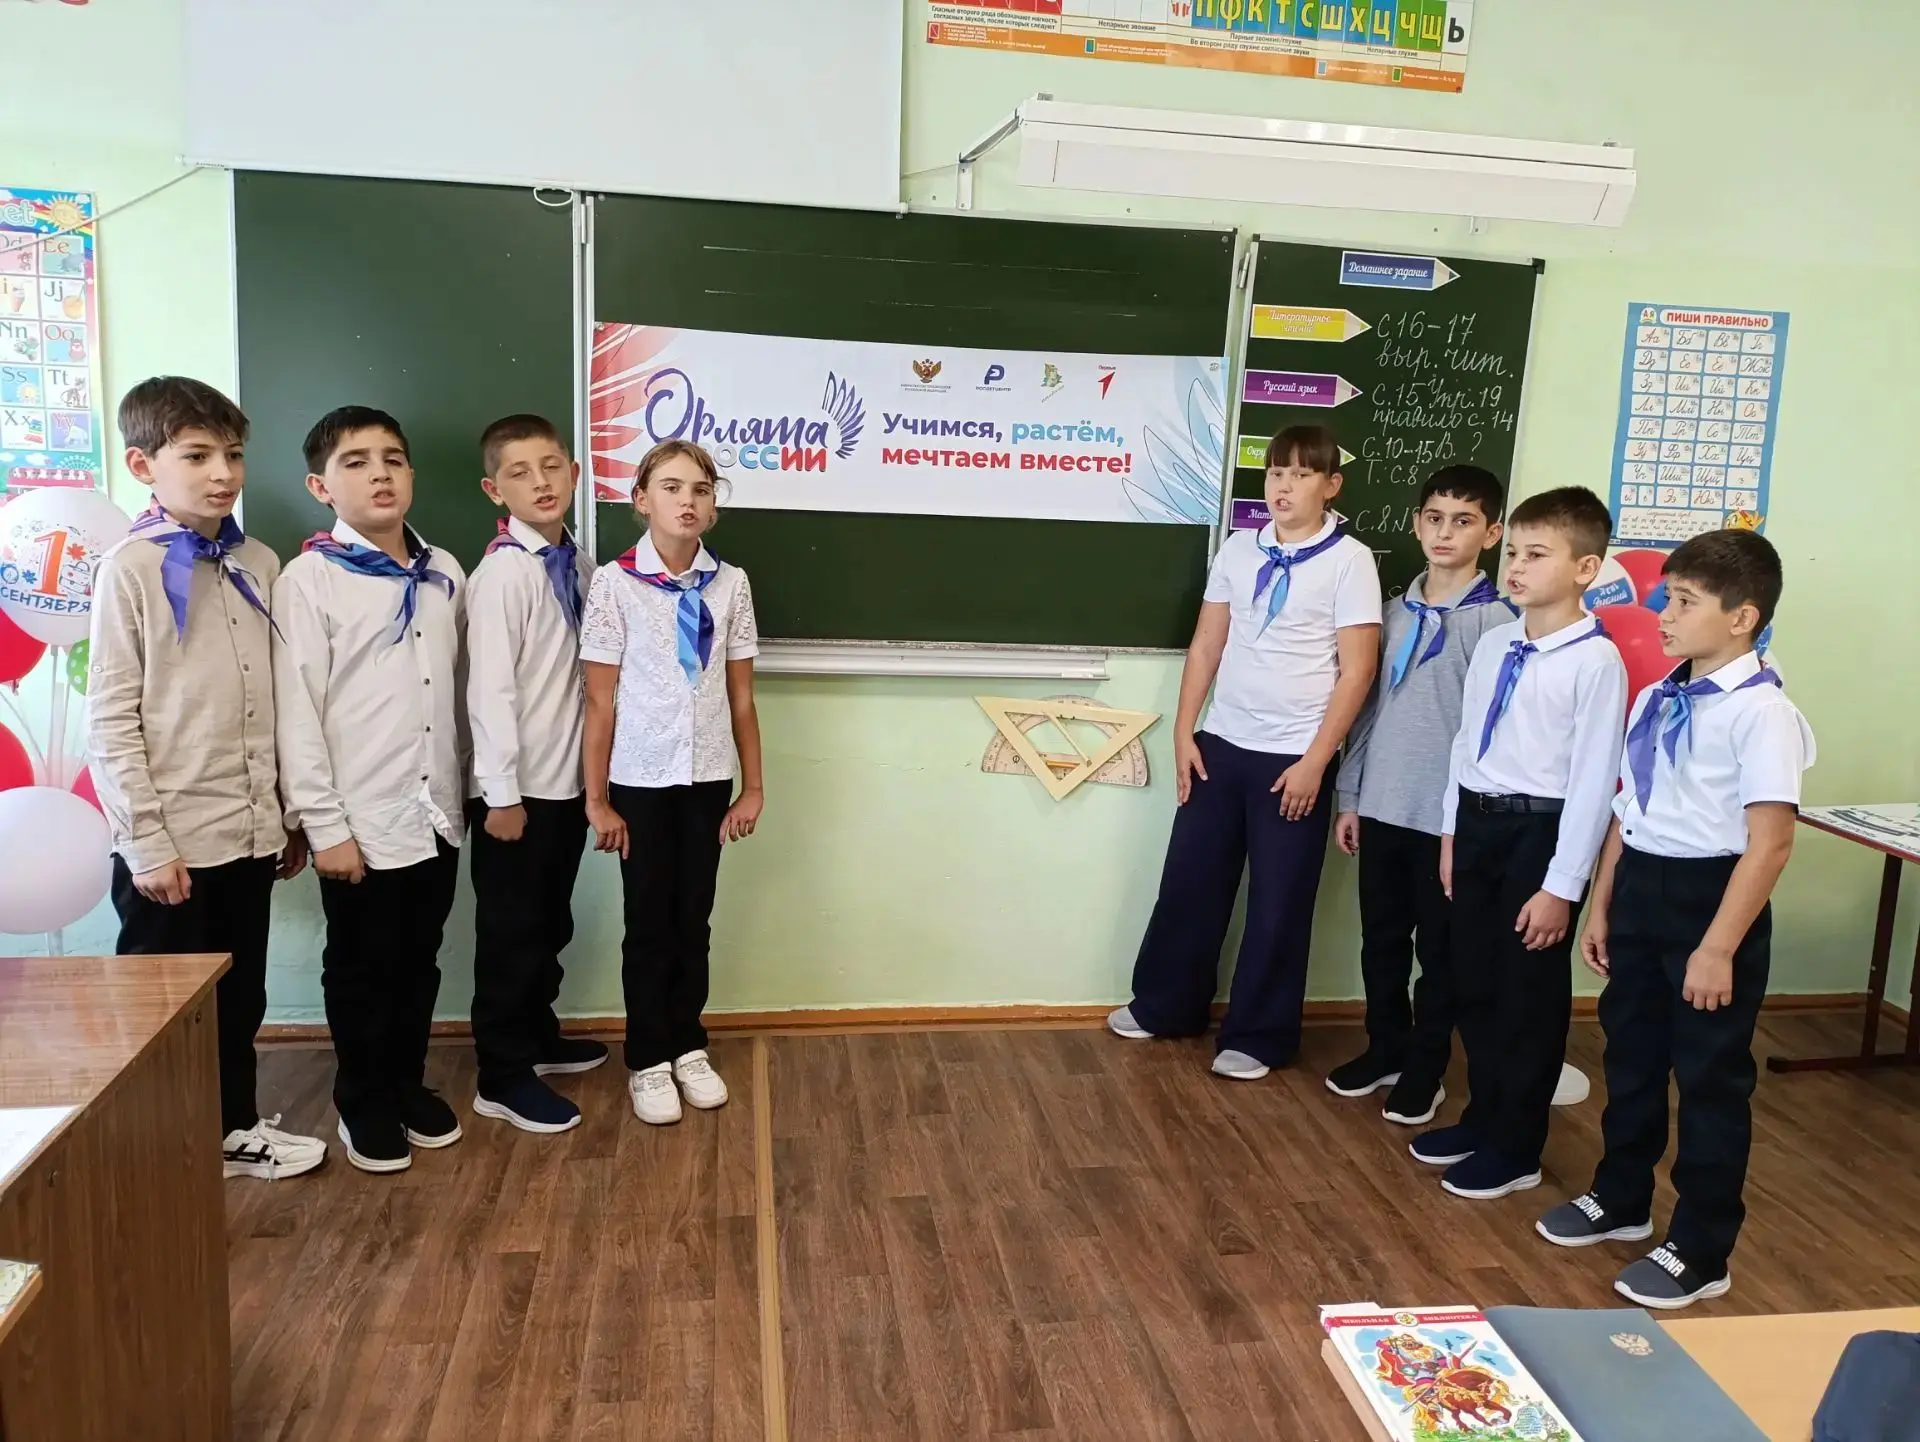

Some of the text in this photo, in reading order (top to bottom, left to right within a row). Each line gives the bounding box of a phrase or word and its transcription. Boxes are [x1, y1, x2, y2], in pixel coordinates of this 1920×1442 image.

[931, 6, 956, 14] Гласные
[957, 8, 981, 16] второго
[996, 12, 1031, 21] обозначают
[1031, 16, 1058, 24] мягкость
[933, 13, 964, 21] согласных
[965, 16, 986, 24] звуков,
[1005, 20, 1029, 28] которых
[1030, 22, 1056, 31] следуют
[1098, 20, 1157, 32] Непарные звонкие
[1230, 32, 1255, 42] Парные
[1199, 40, 1222, 49] втором
[1223, 43, 1239, 51] ряду
[1239, 44, 1260, 52] глухие
[1261, 45, 1293, 54] согласные
[1366, 46, 1418, 58] Непарные глухие
[1349, 261, 1428, 281] Домашнее задание
[44, 281, 63, 303] Jj
[1267, 309, 1332, 325] Литературное
[1666, 312, 1769, 329] ПИШИ ПРАВИЛЬНО
[44, 324, 75, 342] Oo
[2, 366, 70, 386] Ss Tt
[1263, 380, 1319, 397] Русский язык
[644, 367, 829, 450] Орлята
[4, 409, 31, 427] Xx
[1372, 405, 1463, 438] правило
[882, 412, 1124, 447] Учимся, растём,
[702, 443, 828, 473] ОССИИ
[881, 447, 1132, 474] мечтаем вместе!
[1246, 445, 1266, 460] Окру
[33, 529, 69, 598] 1
[0, 586, 91, 613] СЕНТЯБРЯ
